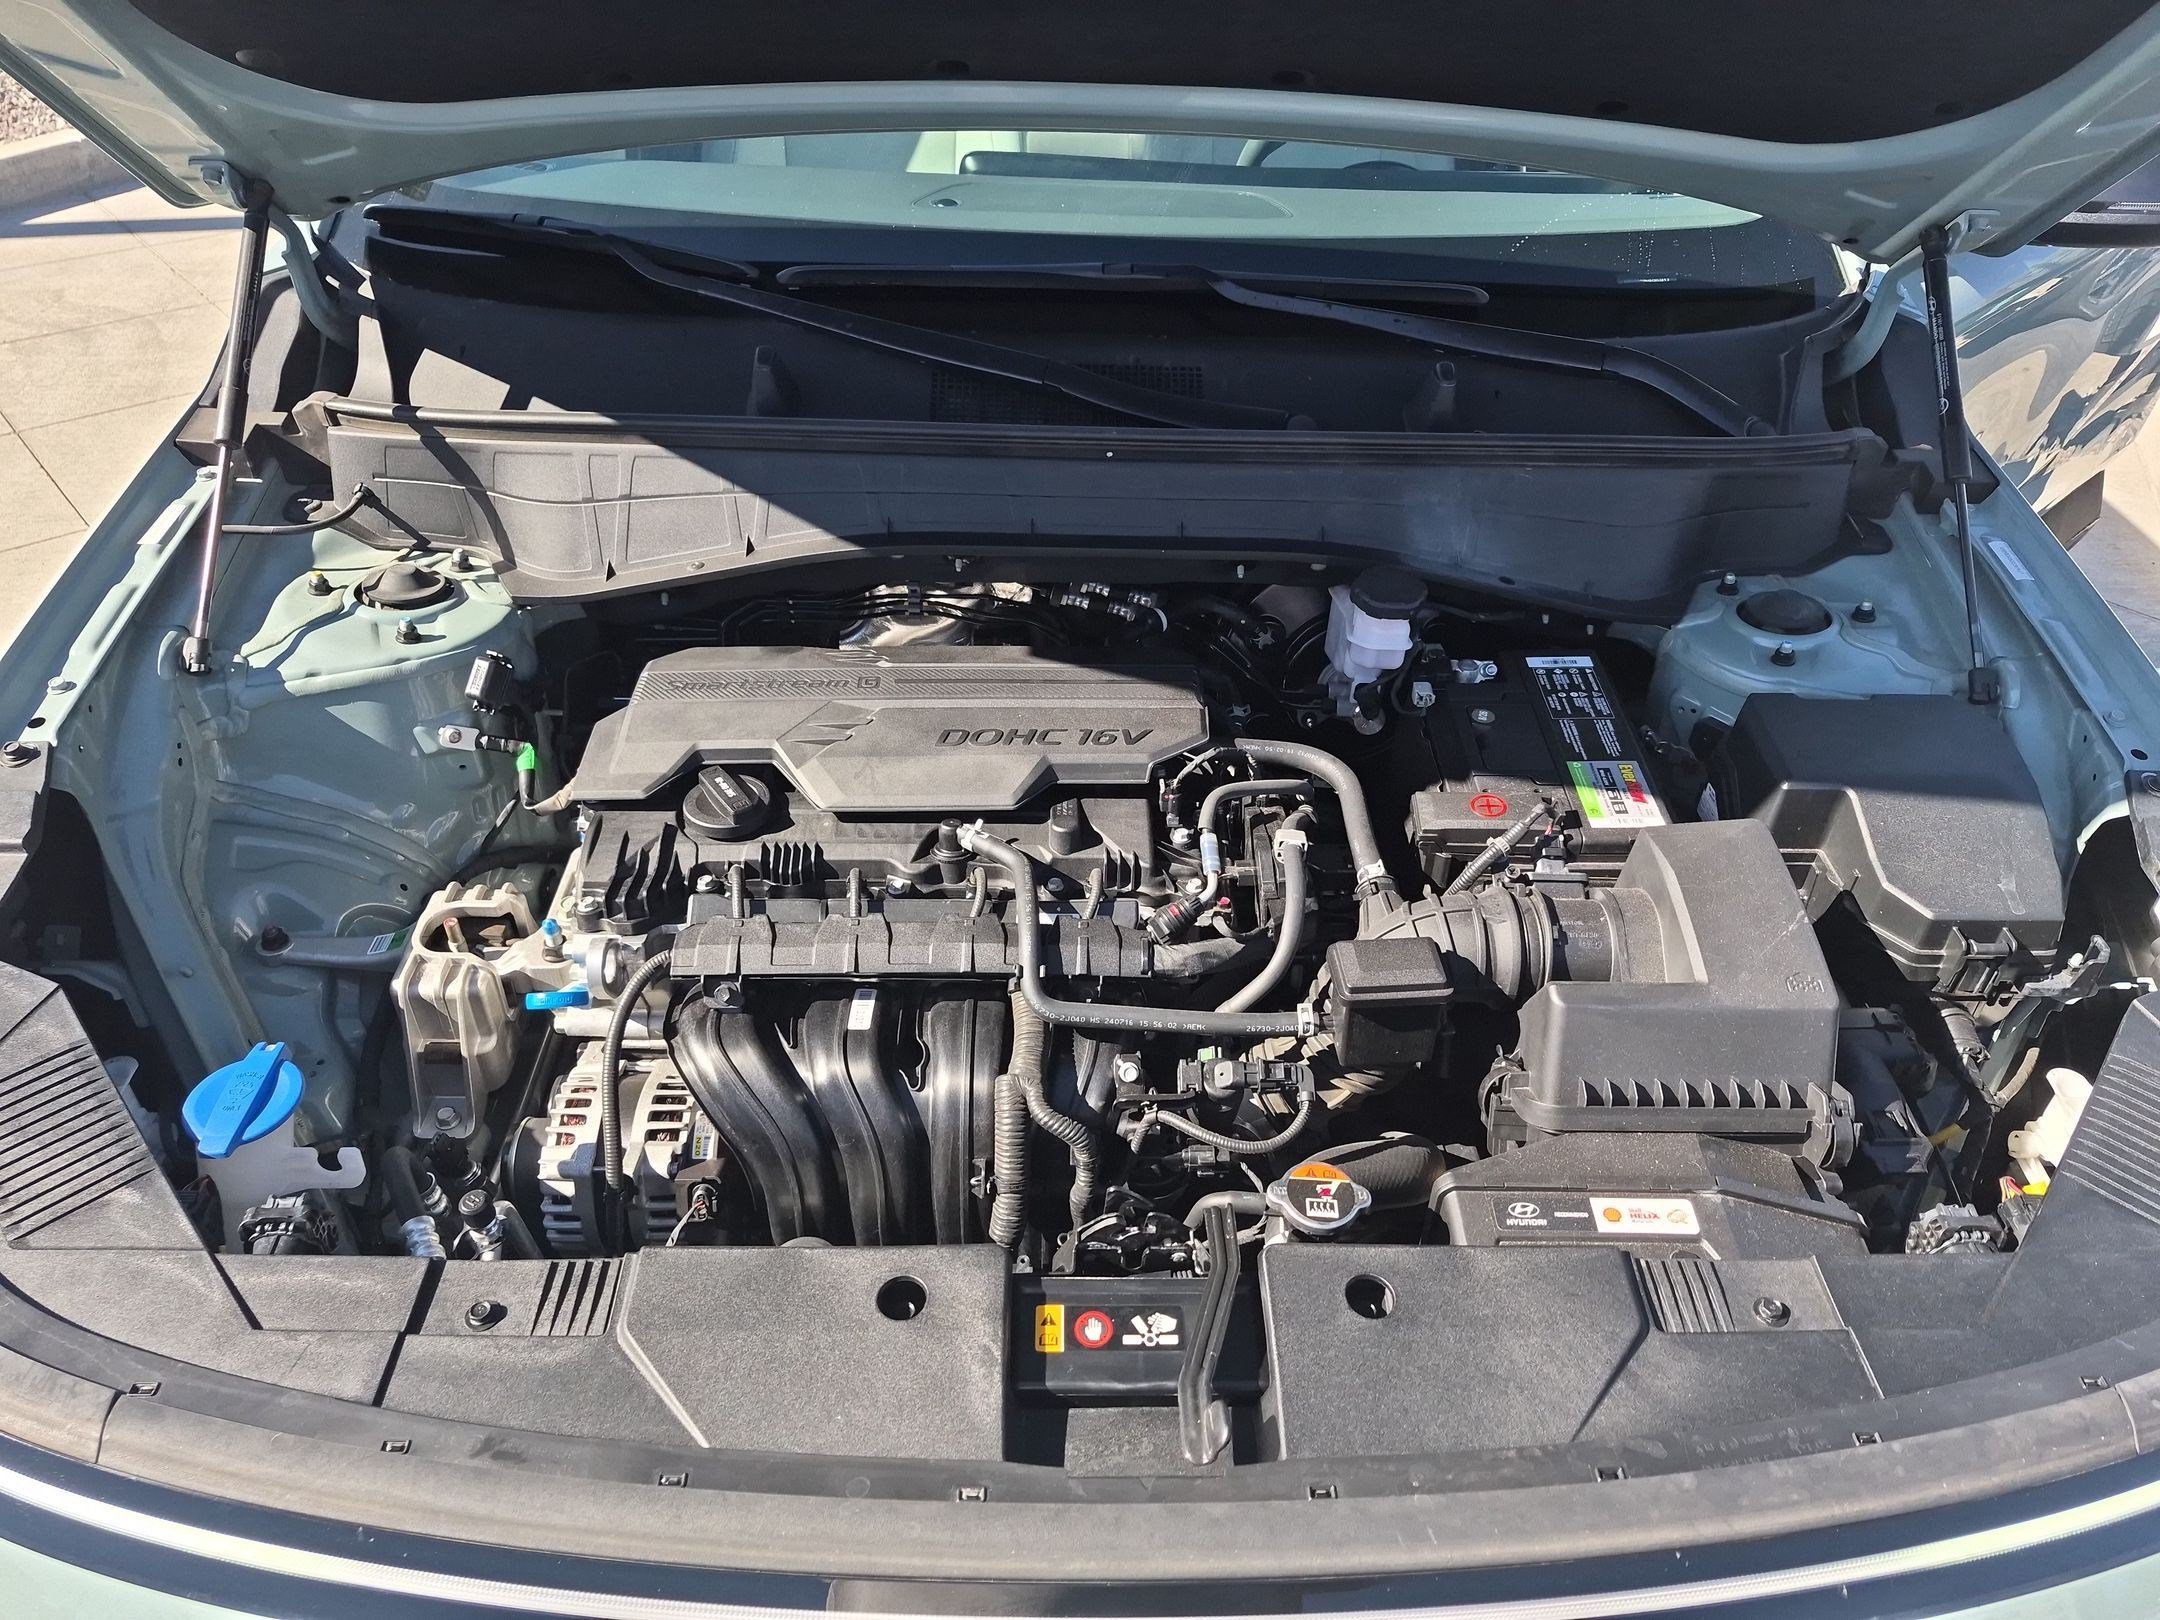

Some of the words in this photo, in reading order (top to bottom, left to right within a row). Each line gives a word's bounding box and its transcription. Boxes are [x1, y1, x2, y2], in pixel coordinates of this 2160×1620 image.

[663, 678, 850, 692] Smartstream
[935, 728, 1069, 747] DOHC
[1078, 728, 1154, 746] 16V
[1030, 999, 1086, 1023] 26730-2J040
[1089, 1016, 1101, 1025] HS
[1104, 1018, 1134, 1026] 240716
[1506, 1218, 1548, 1227] HYUNDAI
